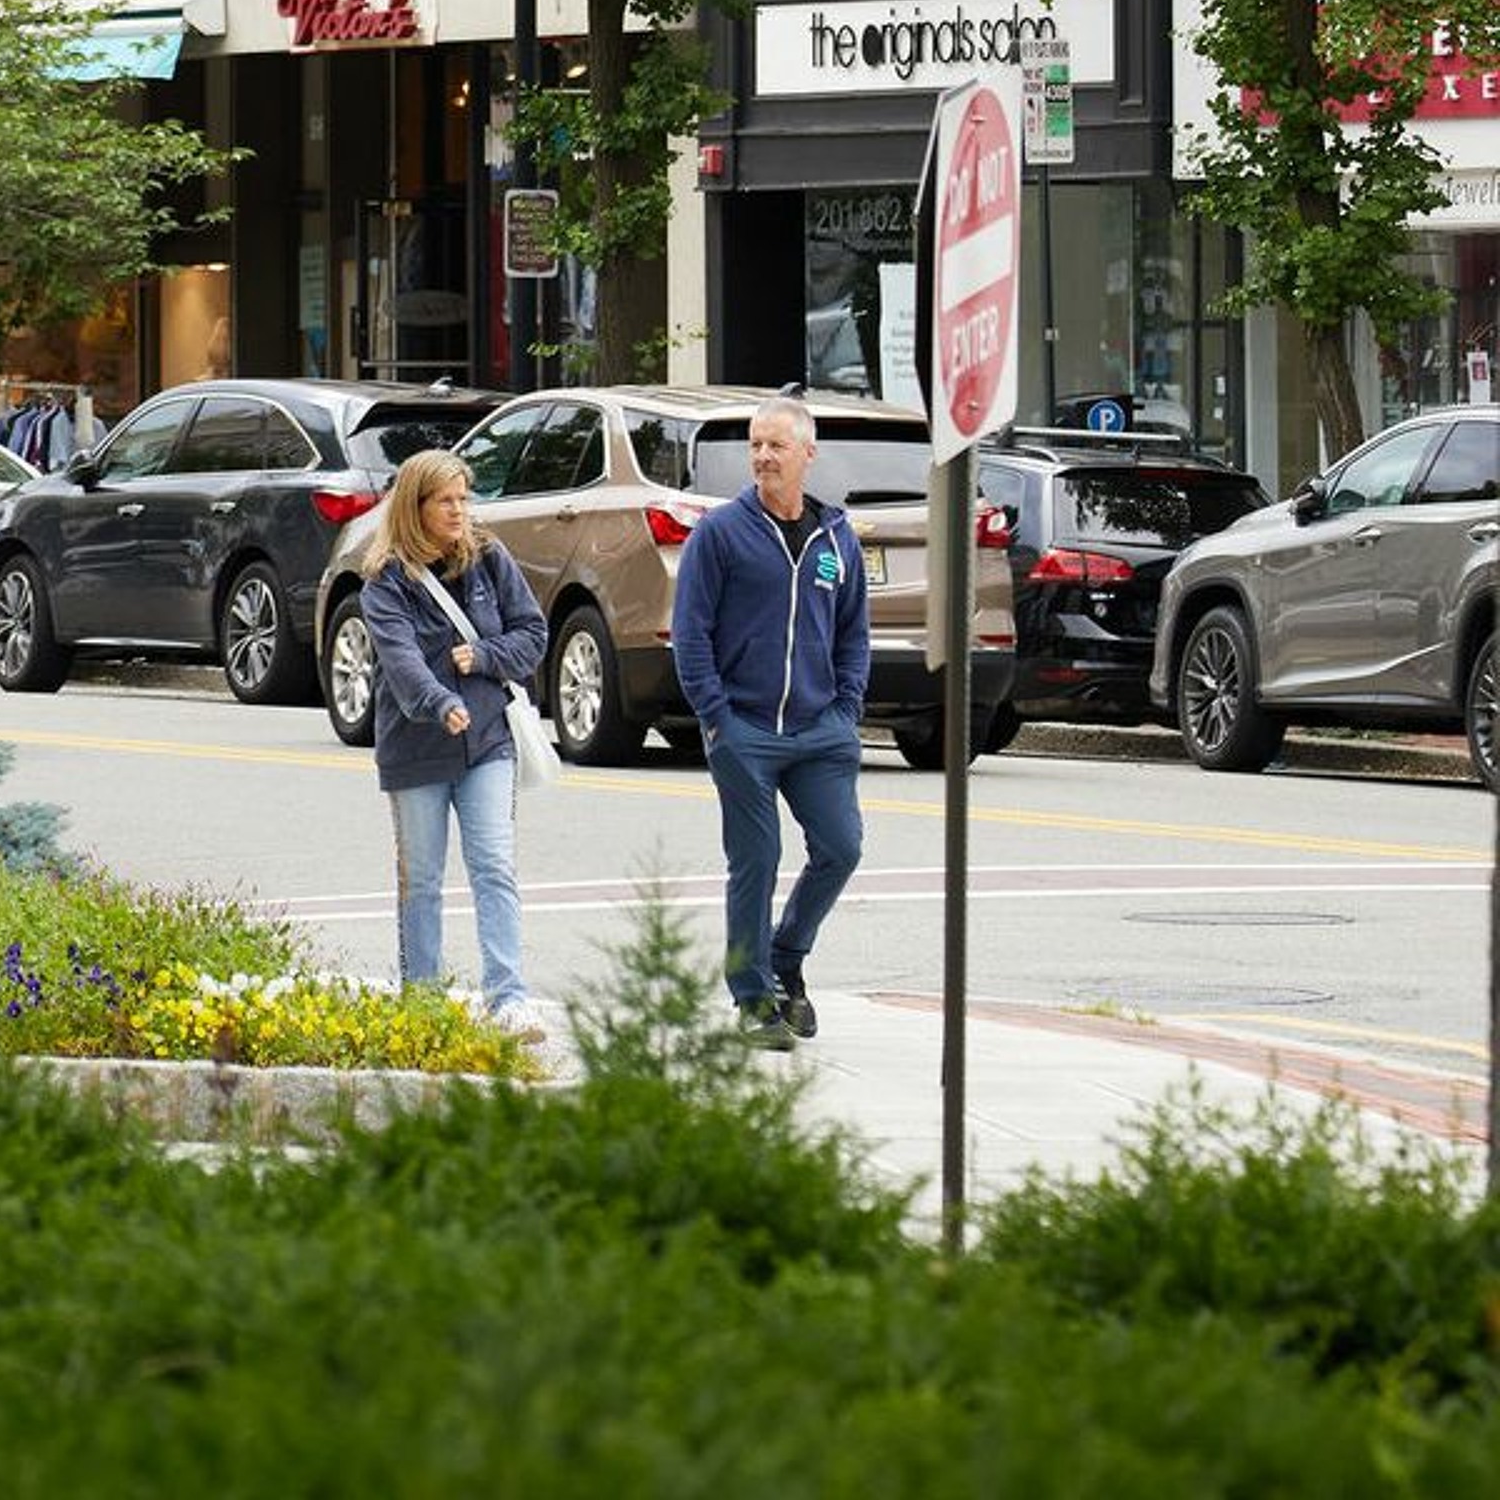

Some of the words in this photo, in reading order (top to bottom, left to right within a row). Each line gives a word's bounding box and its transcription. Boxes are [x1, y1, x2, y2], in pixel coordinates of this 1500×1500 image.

[810, 11, 857, 69] the
[861, 6, 974, 80] originals
[949, 166, 969, 226] DO
[978, 146, 1008, 209] NOT
[951, 305, 999, 377] ENTER
